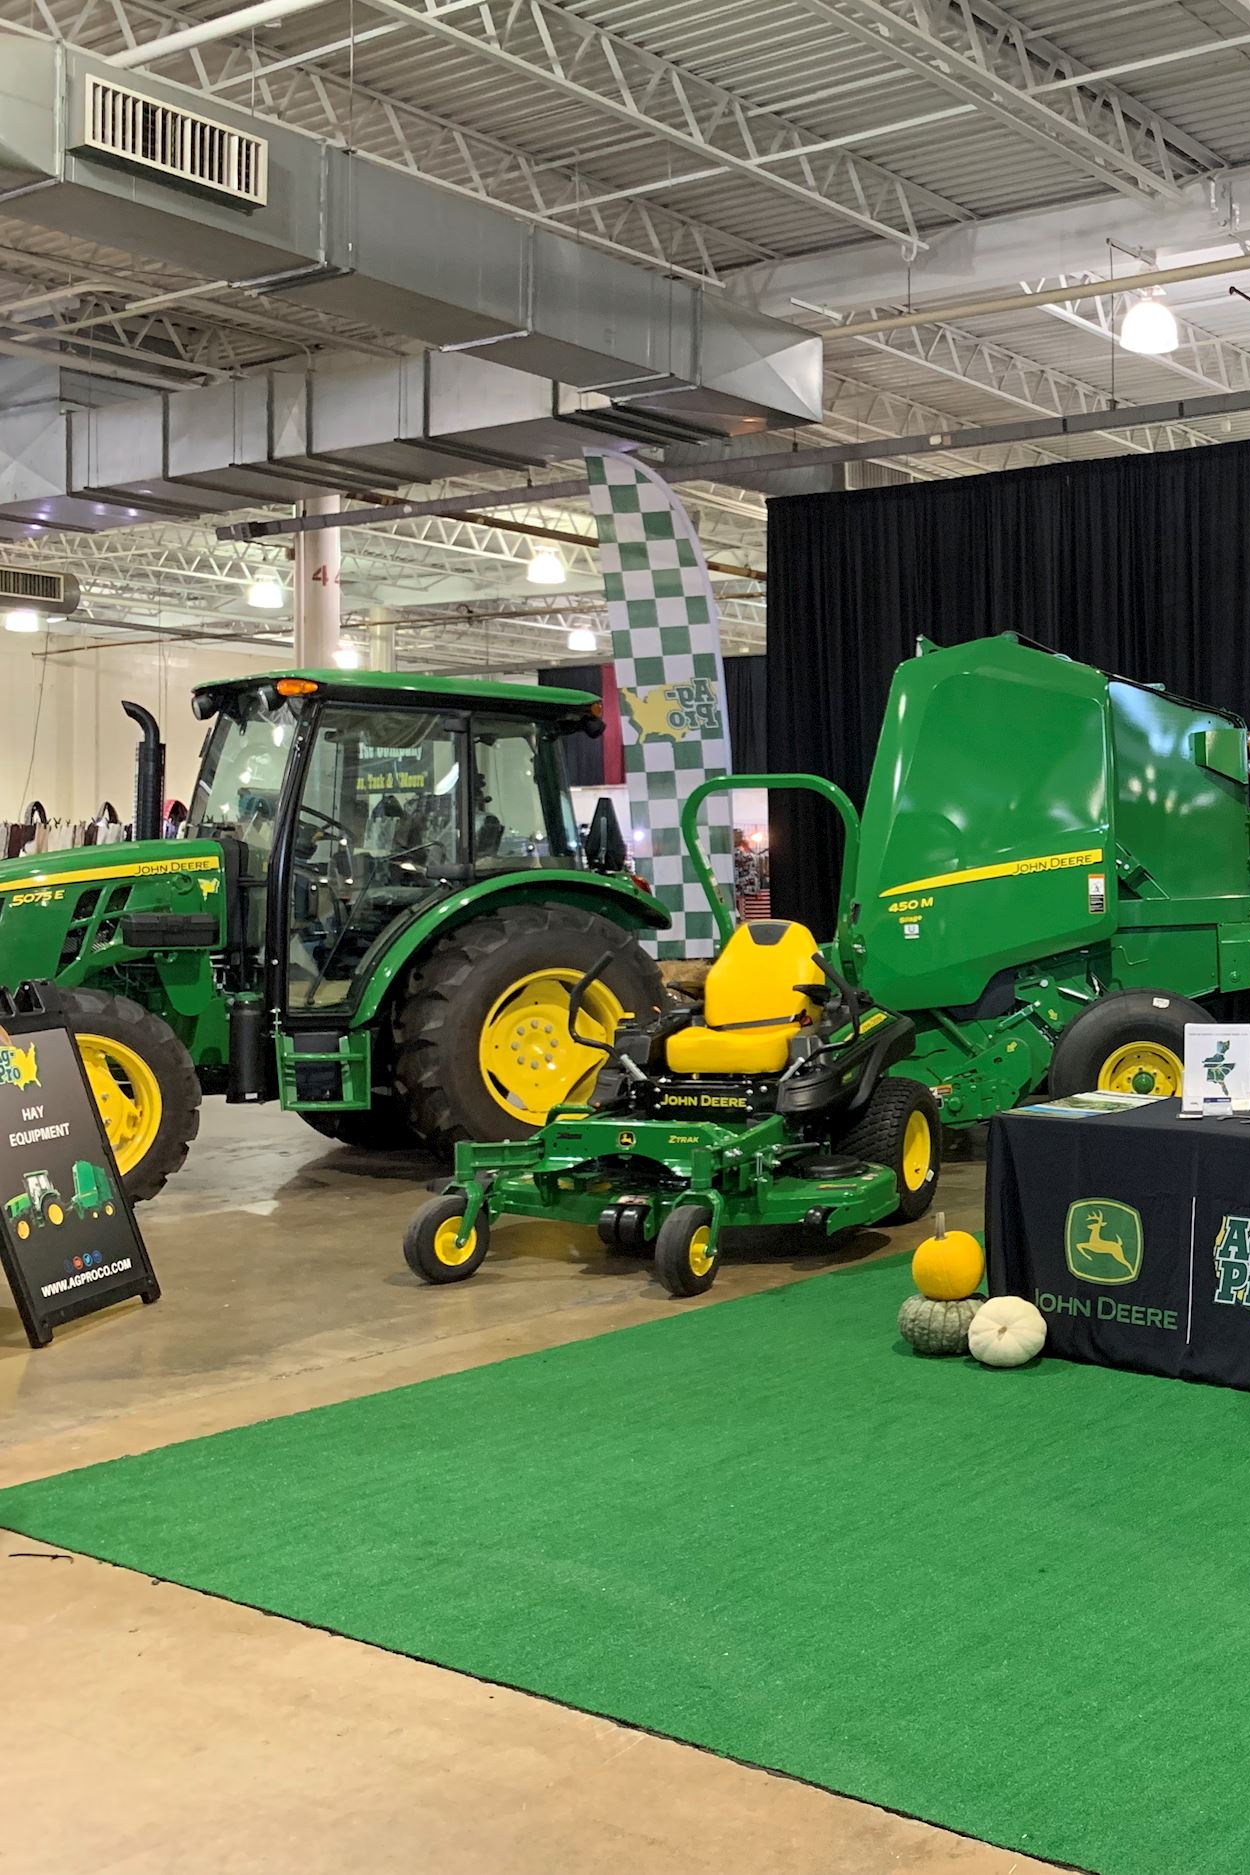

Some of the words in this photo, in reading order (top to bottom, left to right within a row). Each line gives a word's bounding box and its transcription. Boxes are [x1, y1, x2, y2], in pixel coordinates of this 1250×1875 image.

[312, 565, 328, 586] 4
[134, 865, 168, 876] JOHN
[171, 860, 210, 873] DEERE
[1012, 861, 1047, 875] JOHN
[1050, 855, 1092, 868] DEERE
[10, 891, 51, 907] 5075
[888, 900, 919, 912] 450
[920, 896, 934, 908] M
[660, 1094, 698, 1106] JOHN
[700, 1095, 747, 1107] DEERE
[22, 1105, 44, 1122] HAY
[9, 1122, 71, 1147] EQUIPMENT
[668, 1135, 700, 1144] ZTRAK
[41, 1258, 132, 1298] WWW.AGPROCO.COM
[1097, 1296, 1179, 1331] DEERE
